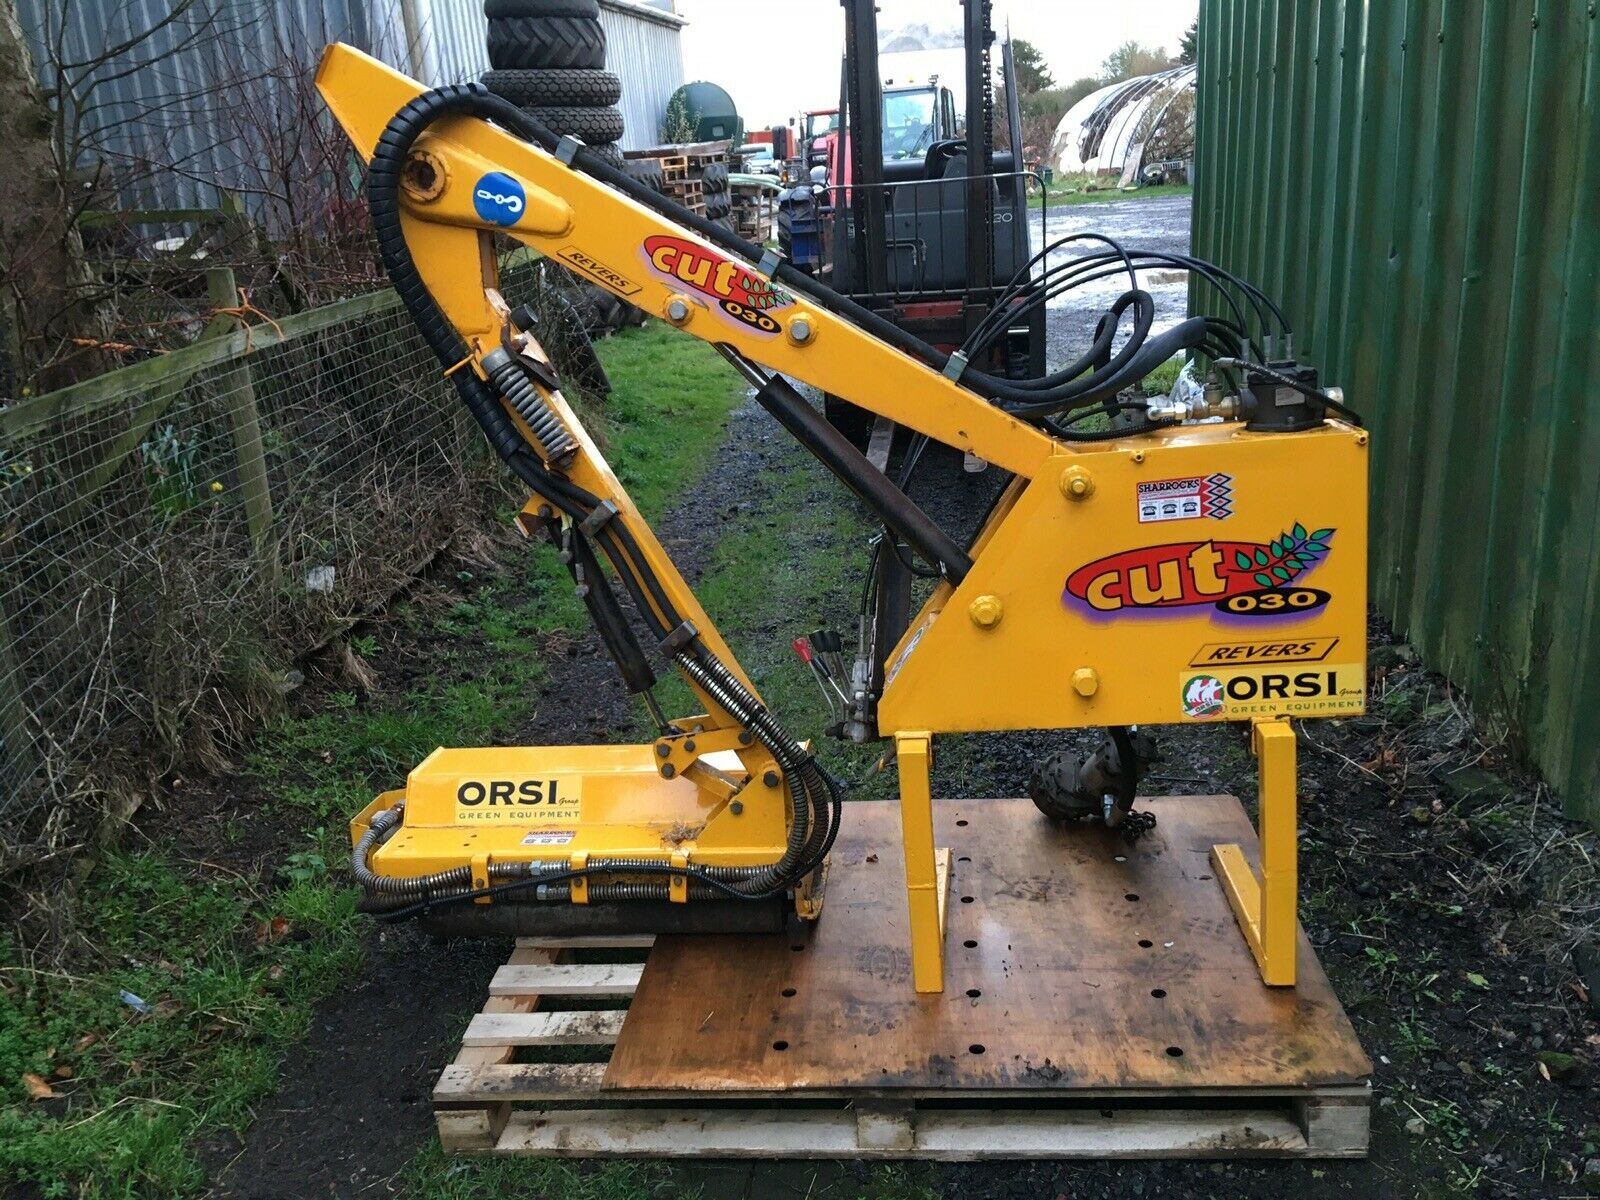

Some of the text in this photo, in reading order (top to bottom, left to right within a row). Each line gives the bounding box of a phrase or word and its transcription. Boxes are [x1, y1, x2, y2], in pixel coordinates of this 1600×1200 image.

[568, 252, 630, 288] REVERS
[651, 246, 737, 296] cut
[725, 302, 775, 330] 030
[1138, 479, 1200, 493] SHARROCKS
[1086, 540, 1228, 611] cut
[1228, 591, 1317, 611] 030
[1207, 642, 1317, 660] REVERS
[1226, 672, 1338, 700] ORSI
[1195, 701, 1214, 713] ORSI
[1231, 701, 1363, 714] GREEN EQUIPMENT
[457, 780, 559, 806] ORSI
[509, 811, 580, 819] EQUIPMENT
